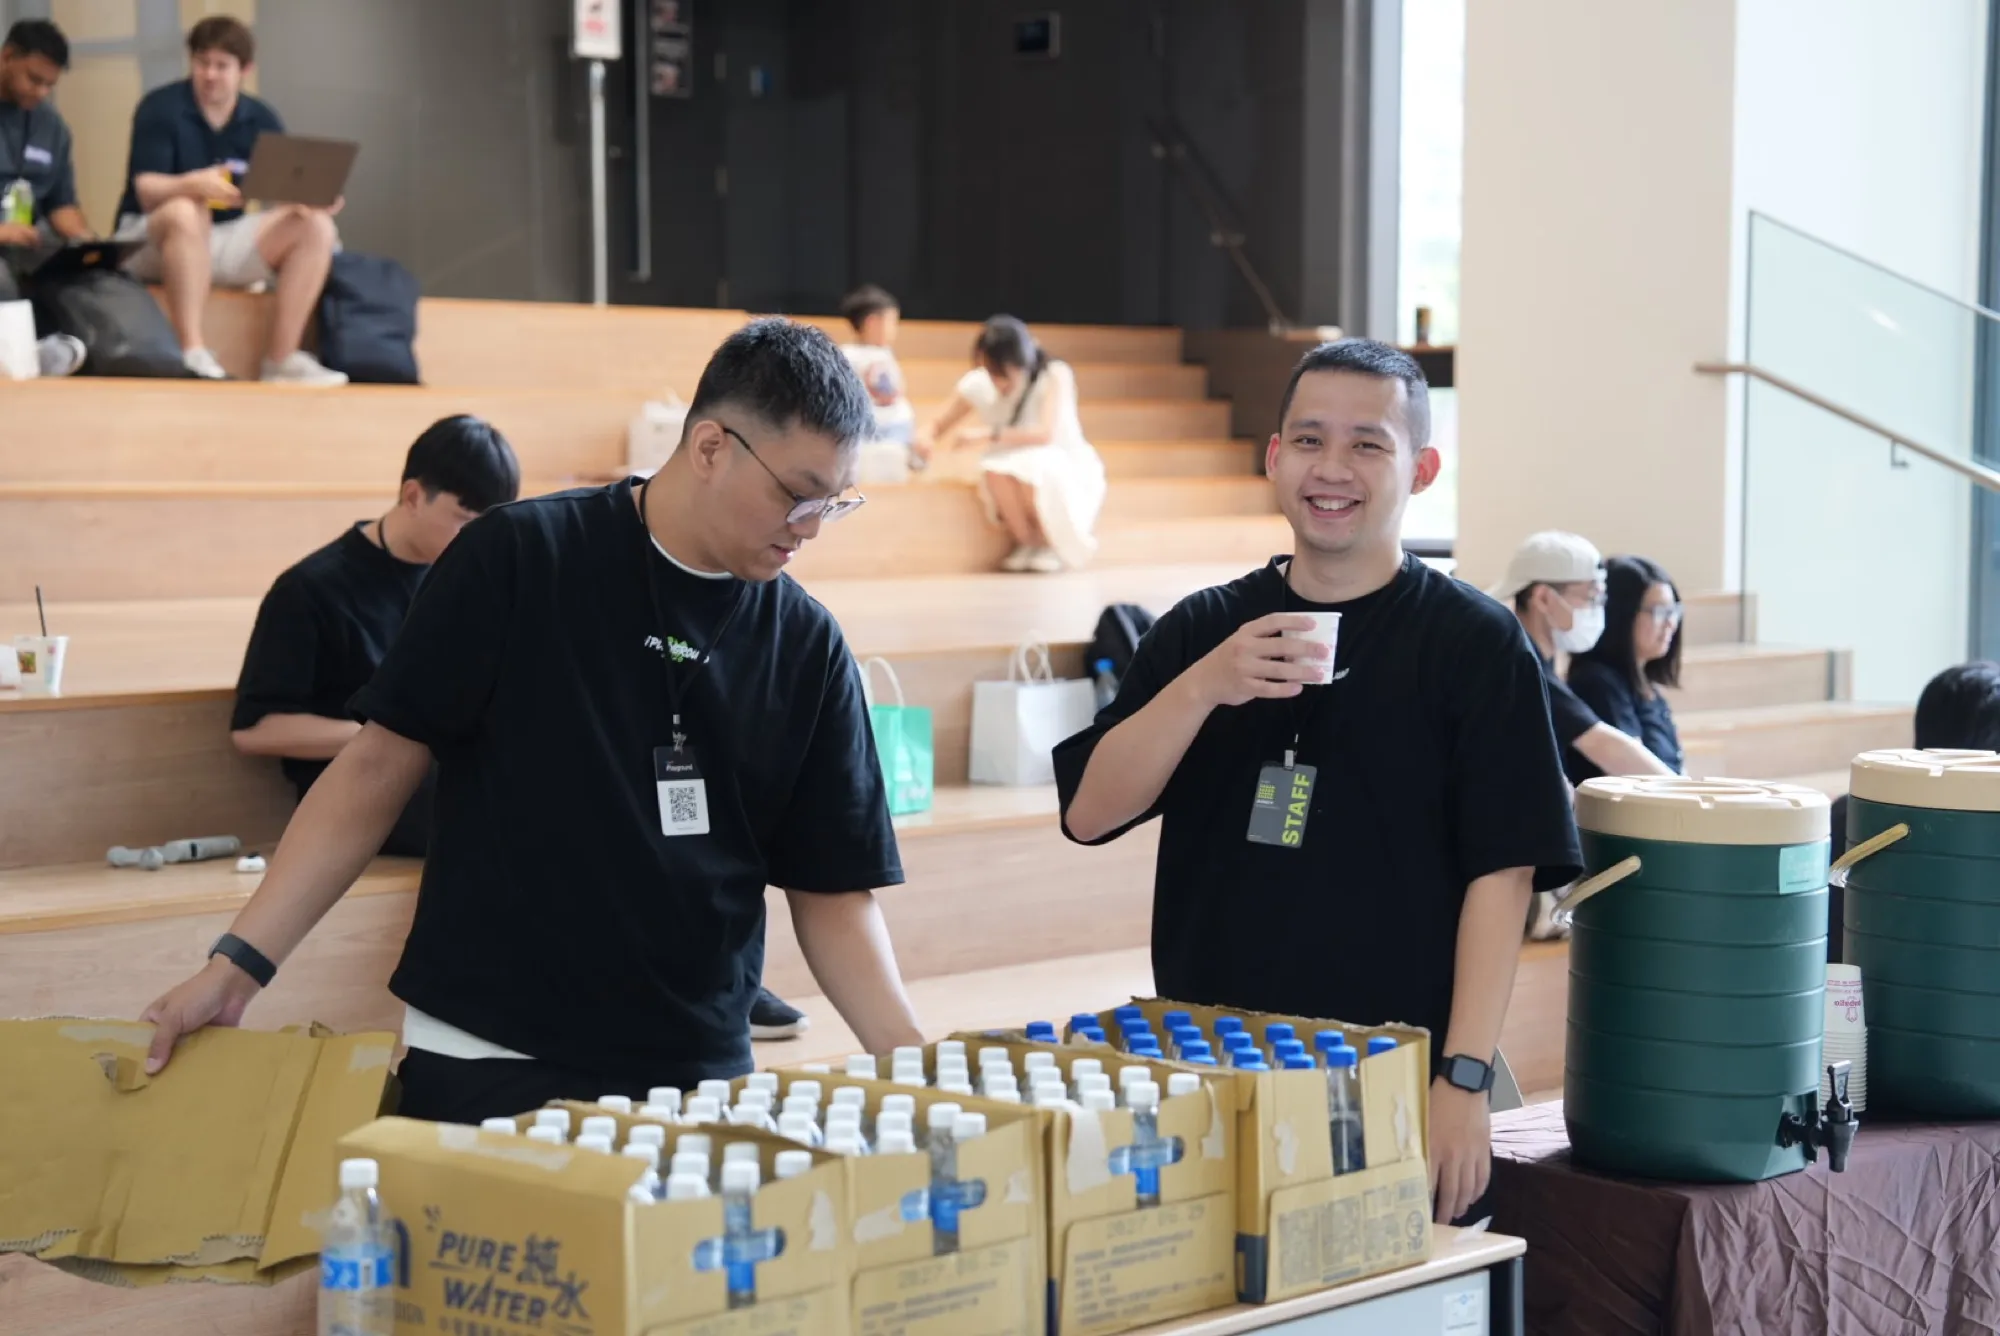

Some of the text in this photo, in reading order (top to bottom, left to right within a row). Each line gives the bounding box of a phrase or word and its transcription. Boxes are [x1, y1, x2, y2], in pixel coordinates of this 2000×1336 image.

[1282, 773, 1310, 845] STAFF
[437, 1231, 518, 1274] PURE
[443, 1272, 547, 1326] WATER
